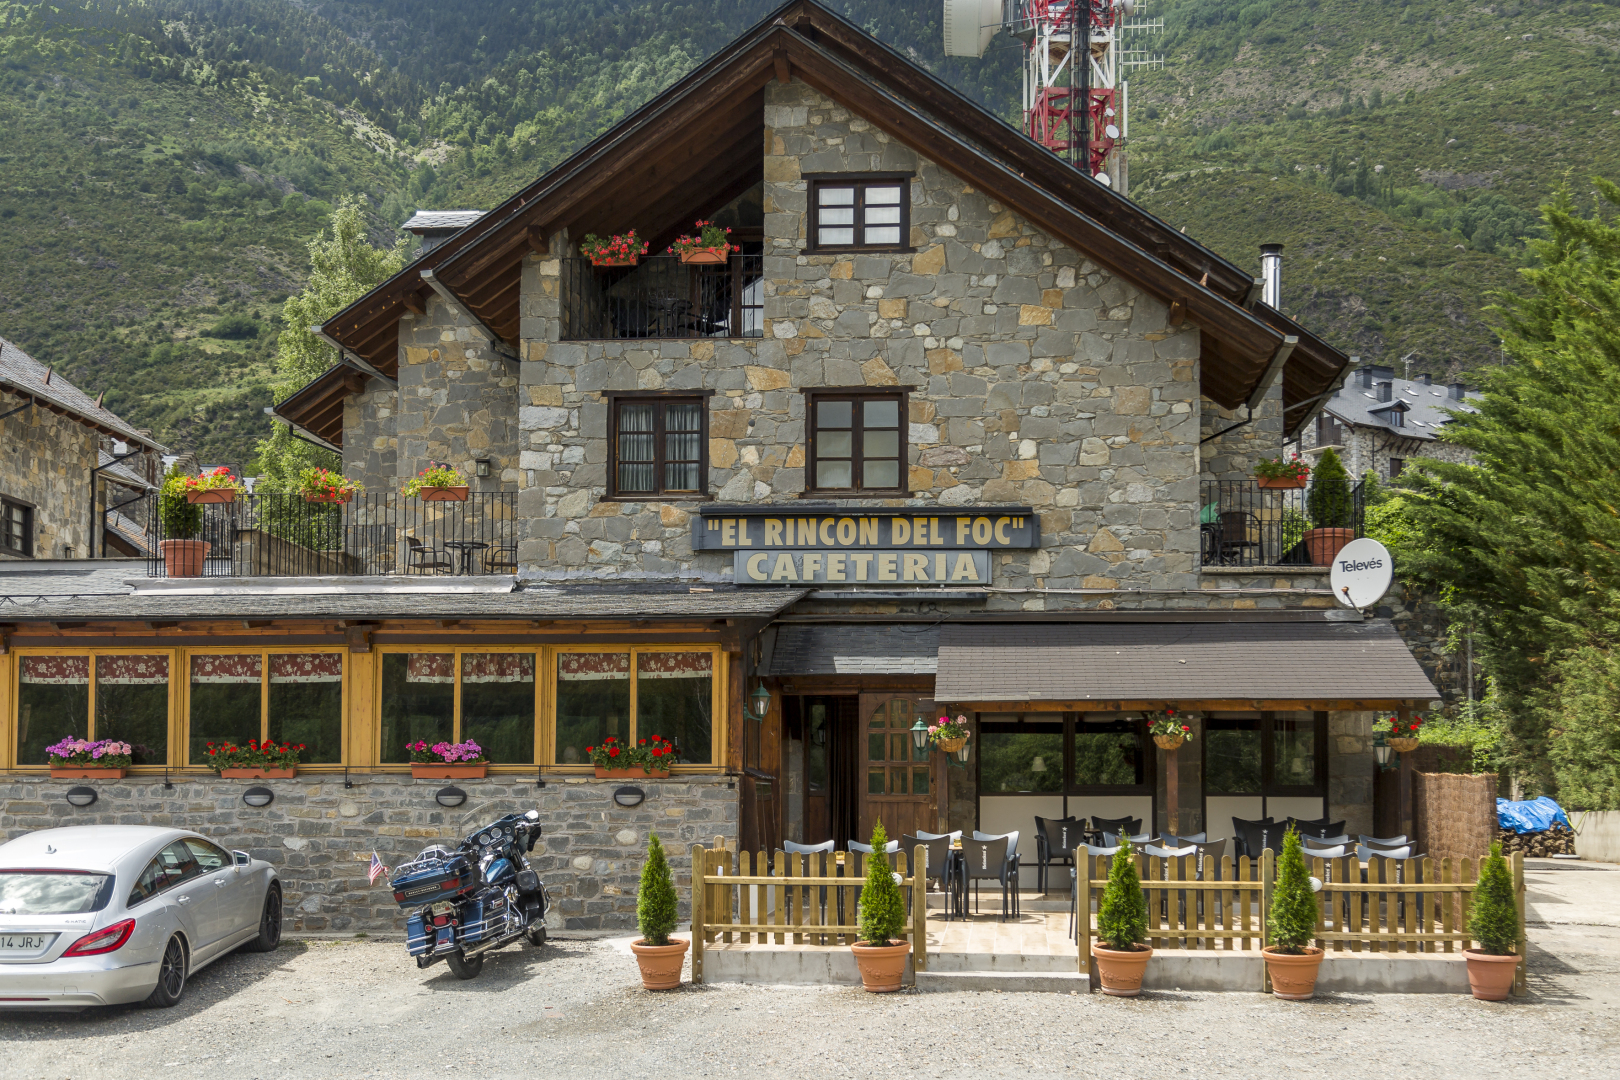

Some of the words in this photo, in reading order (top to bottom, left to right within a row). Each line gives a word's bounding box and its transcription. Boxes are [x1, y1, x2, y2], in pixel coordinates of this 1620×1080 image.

[707, 518, 752, 546] "EL
[764, 517, 879, 546] RINCON
[892, 517, 943, 546] DEL
[956, 516, 1024, 546] FOC"
[746, 553, 980, 581] CAFETERIA
[1339, 557, 1383, 573] Televés
[1, 936, 14, 948] 14
